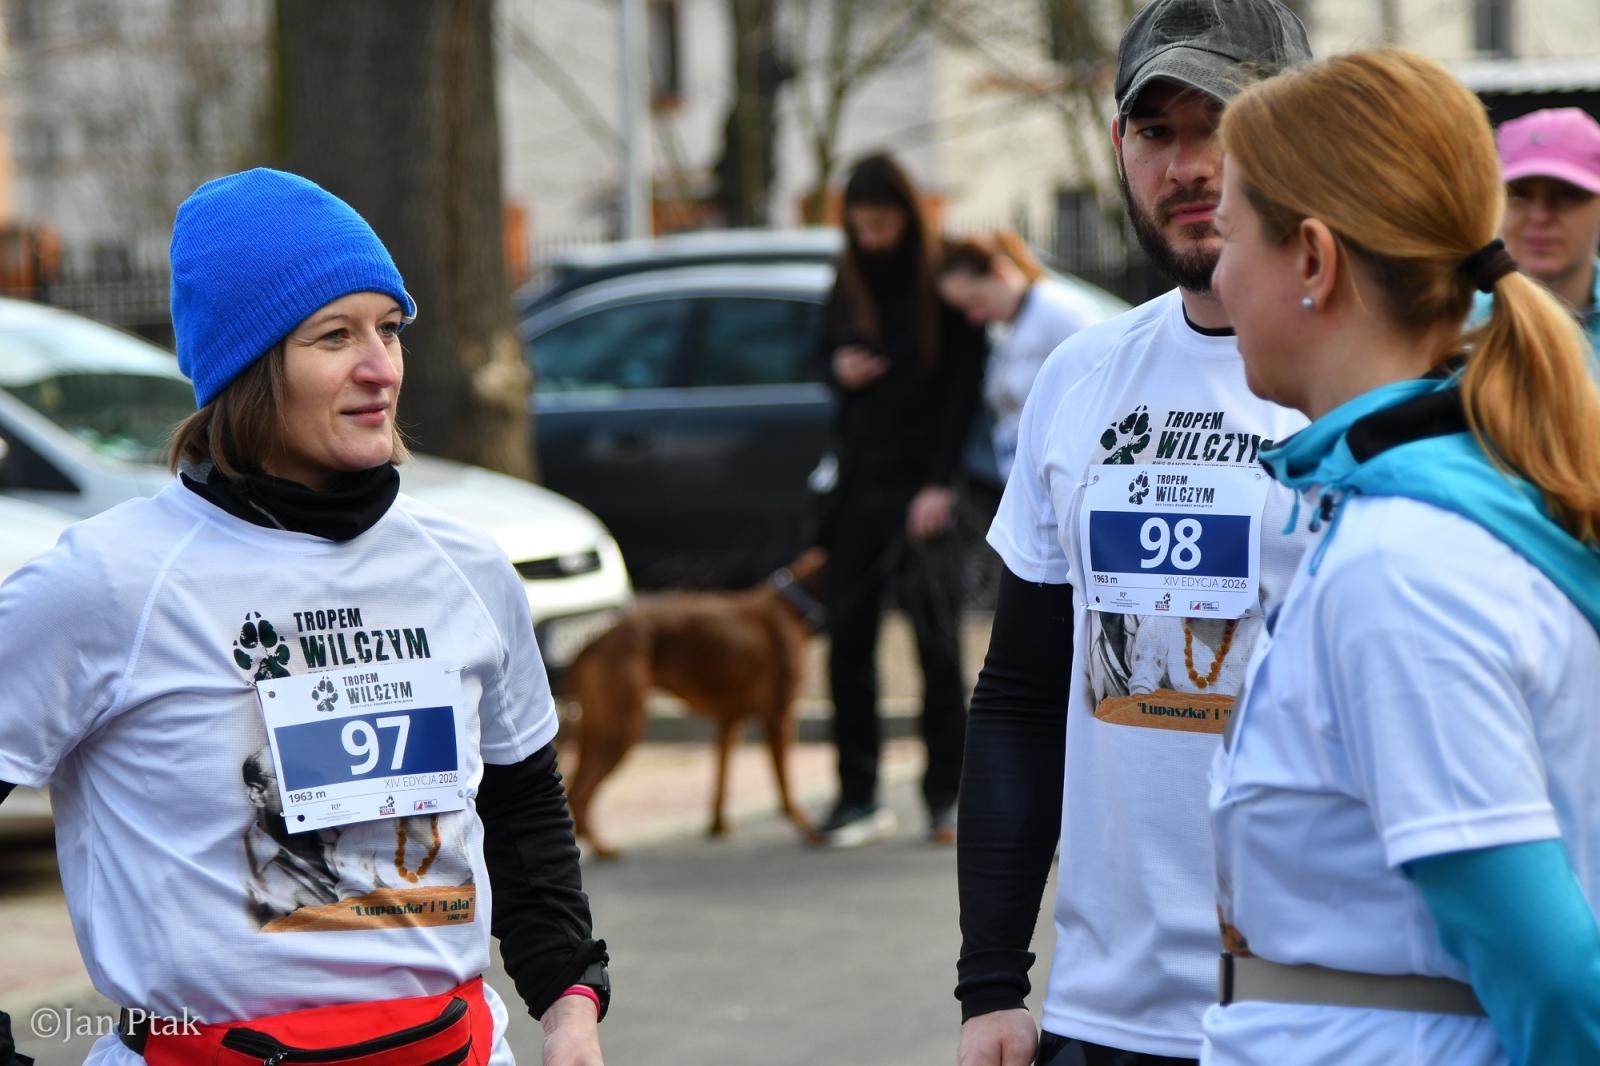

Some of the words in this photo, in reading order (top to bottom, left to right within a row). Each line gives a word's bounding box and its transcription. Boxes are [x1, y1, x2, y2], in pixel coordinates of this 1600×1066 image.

[1165, 410, 1224, 430] TROPEM
[1156, 474, 1188, 485] TROPEM
[1156, 485, 1215, 504] WILCZYM
[1139, 516, 1203, 571] 98
[1093, 574, 1109, 584] 1963
[1110, 577, 1118, 585] m
[1163, 576, 1180, 587] XIV
[1181, 577, 1219, 588] EDYCJA
[1221, 578, 1248, 590] 2026
[293, 607, 364, 633] TROPEM
[299, 627, 432, 669] WILCZYM
[342, 672, 379, 687] TROPEM
[345, 681, 414, 705] WILCZYM
[340, 714, 411, 776] 97
[383, 776, 400, 789] XIV
[402, 774, 438, 788] EDYCJA
[438, 772, 459, 785] 2026
[288, 790, 313, 804] 1963
[315, 790, 327, 800] m
